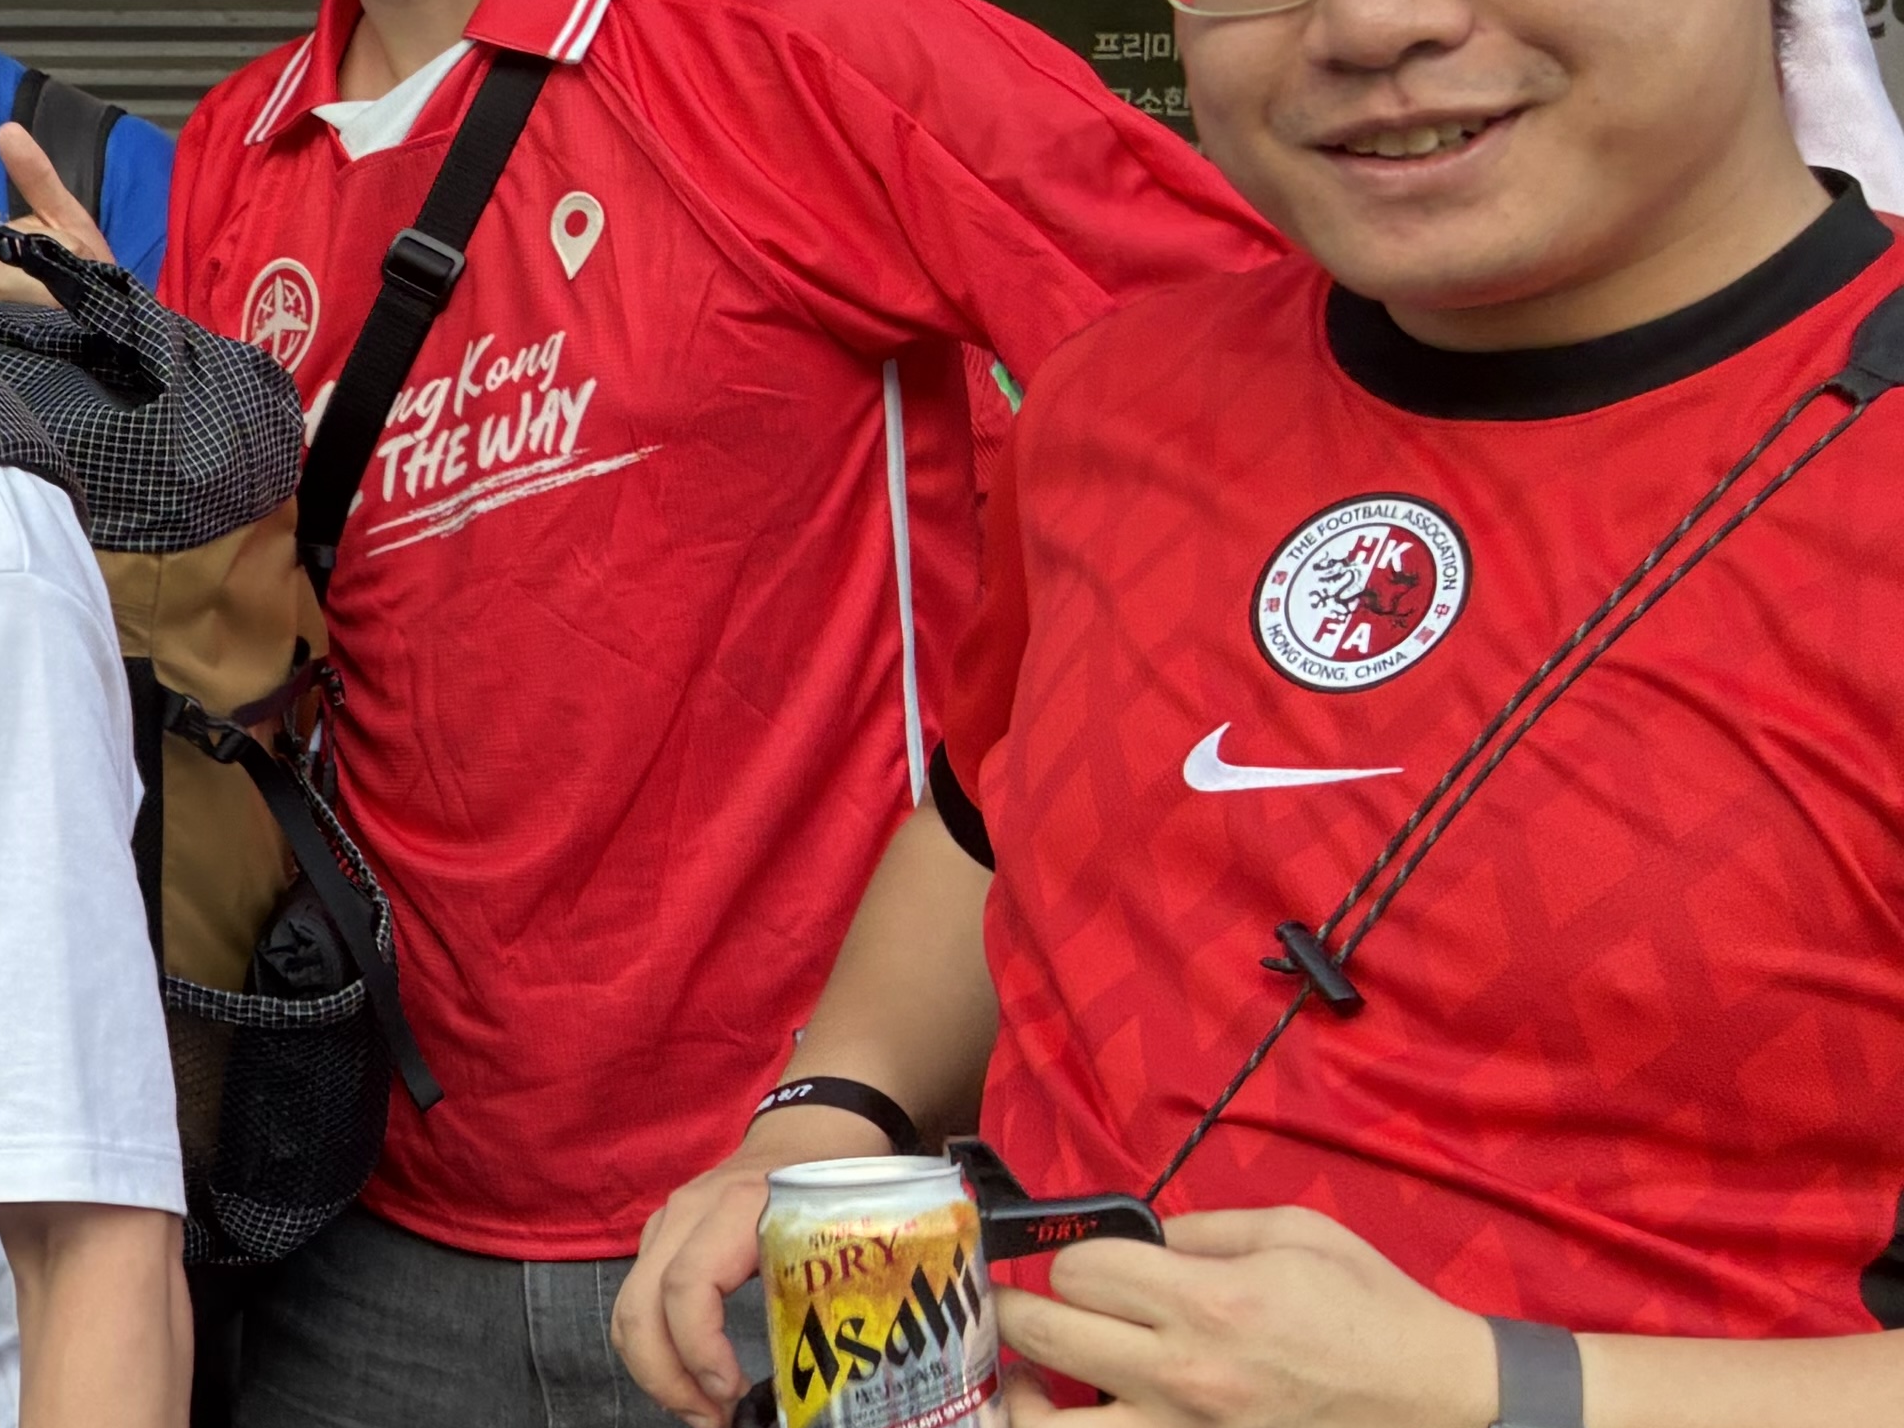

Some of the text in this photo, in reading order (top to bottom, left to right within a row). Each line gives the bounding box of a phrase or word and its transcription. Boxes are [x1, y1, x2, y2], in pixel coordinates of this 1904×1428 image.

[1092, 31, 1182, 63] 프리미
[454, 329, 566, 417] Kong
[376, 377, 597, 503] THE WAY
[1286, 503, 1458, 592] THE FOOTBALL ASSOCIATION
[1347, 534, 1414, 573] HK
[1266, 622, 1300, 666] HONG
[1354, 650, 1409, 680] CHINA
[1312, 615, 1373, 655] FA
[791, 1239, 983, 1405] Asahi
